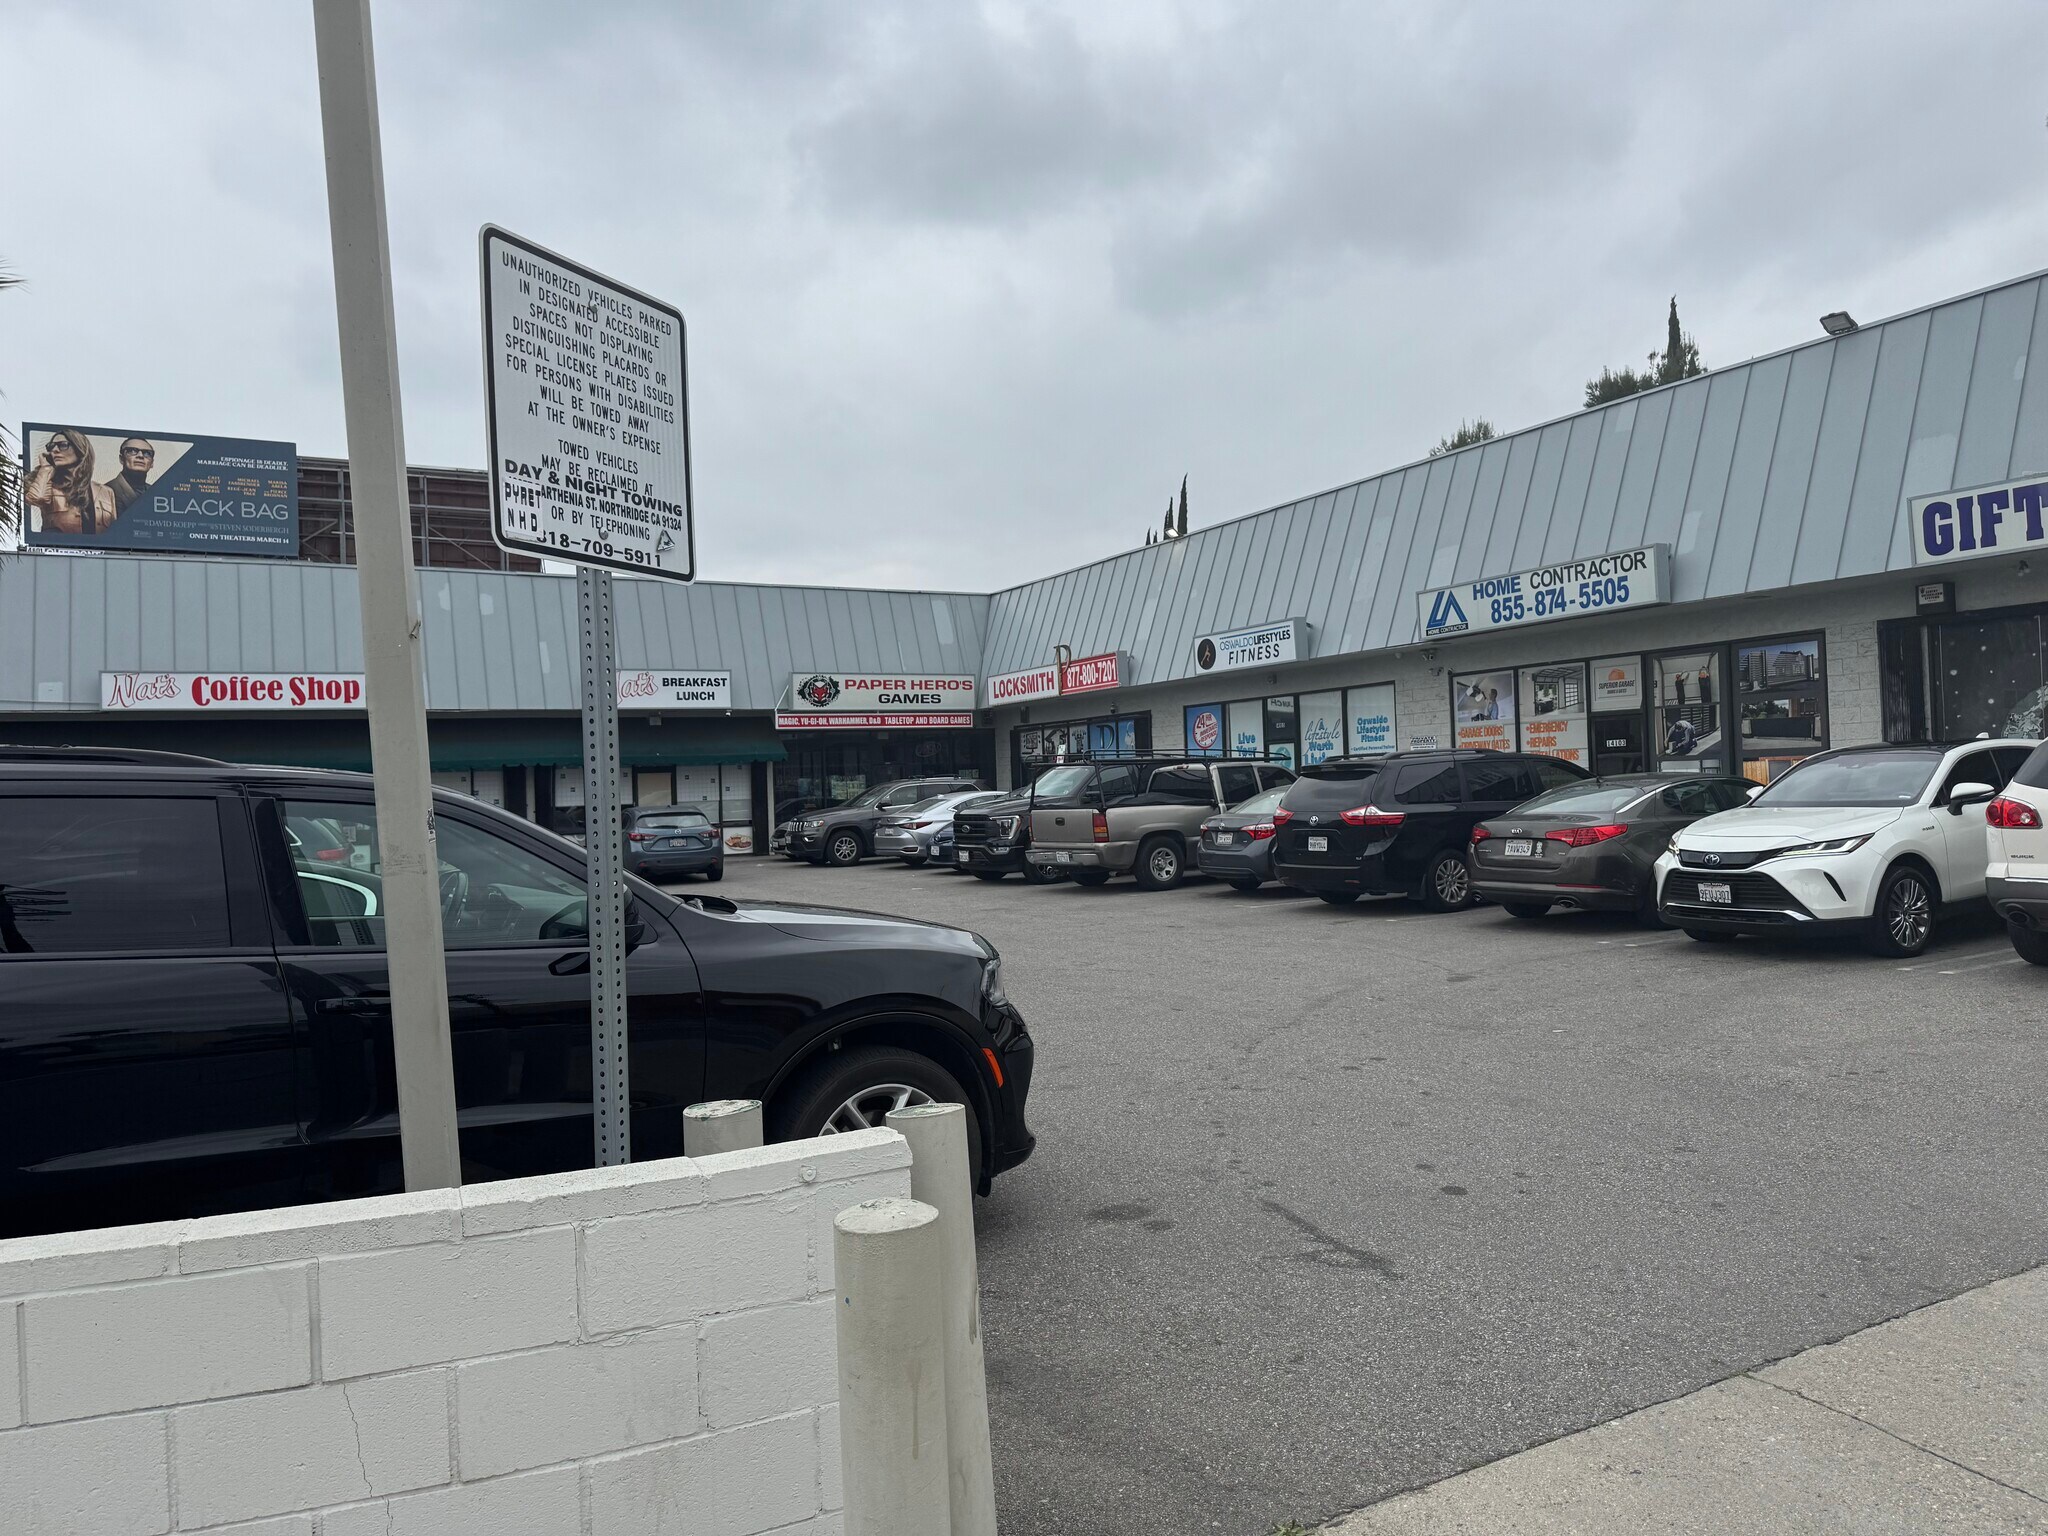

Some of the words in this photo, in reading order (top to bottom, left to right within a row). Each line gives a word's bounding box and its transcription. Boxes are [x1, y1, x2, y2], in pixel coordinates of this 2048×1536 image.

[502, 251, 581, 297] UNAUTHORIZED
[588, 289, 632, 319] VEHICLES
[639, 311, 671, 336] PARKED
[519, 278, 530, 295] IN
[538, 286, 598, 322] DESIGNATED
[605, 315, 660, 349] ACCESSIBLE
[529, 303, 567, 329] SPACES
[575, 321, 593, 340] NOT
[600, 331, 653, 364] DISPLAYING
[513, 316, 595, 359] DISTINGUISHING
[602, 351, 650, 380] PLACARDS
[655, 372, 667, 387] OR
[505, 333, 550, 362] SPECIAL
[556, 351, 598, 379] LICENSE
[604, 370, 637, 393] PLATES
[643, 384, 674, 407] ISSUED
[506, 354, 527, 374] FOR
[535, 364, 582, 392] PERSONS
[589, 382, 611, 403] WITH
[618, 393, 674, 424] DISABILITIES
[540, 385, 564, 406] WILL
[572, 396, 584, 412] BE
[590, 401, 621, 424] TOWED
[627, 415, 650, 433] AWAY
[528, 401, 539, 416] AT
[546, 406, 565, 425] THE
[572, 415, 616, 441] OWNER'S
[622, 431, 661, 455] EXPENSE
[558, 438, 589, 460] TOWED
[596, 450, 638, 475] VEHICLES
[542, 454, 560, 472] MAY
[568, 462, 581, 477] BE
[588, 467, 638, 492] RECLAIMED
[644, 483, 653, 496] AT
[504, 459, 542, 480] DAY
[548, 470, 560, 486] &
[565, 475, 617, 500] NIGHT
[622, 490, 682, 516] TOWING
[154, 496, 234, 517] BLACK
[241, 502, 288, 520] BAG
[541, 485, 584, 508] ARTHENIA
[586, 496, 598, 511] ST.
[600, 499, 649, 524] NORTHRIDGE
[651, 512, 660, 526] CA
[662, 516, 682, 531] 91324
[1922, 481, 2048, 557] GIFT
[149, 520, 172, 528] DAVID
[214, 524, 241, 532] STEVEN
[552, 506, 564, 521] OR
[572, 510, 584, 526] BY
[590, 514, 650, 540] TELEPHONING
[220, 534, 256, 542] THEATERS
[256, 536, 282, 544] MARCH
[1472, 576, 1521, 601] HOME
[1530, 551, 1648, 590] CONTRACTOR
[1428, 628, 1440, 636] HOME
[1440, 624, 1467, 633] CONTRACTOR
[1228, 644, 1280, 665] FITNESS
[107, 673, 181, 708] Nat's
[192, 676, 283, 706] Coffee
[288, 676, 360, 706] Shop
[618, 672, 658, 701] at's
[662, 678, 727, 687] BREAKFAST
[844, 679, 906, 690] PAPER
[910, 679, 974, 690] HERO'S
[993, 670, 1055, 699] LOCKSMITH
[1066, 658, 1117, 688] 877-800-7201
[1598, 681, 1618, 690] SUPERIOR
[1618, 680, 1636, 688] GARAGE
[676, 691, 715, 700] LUNCH
[878, 693, 942, 704] GAMES
[885, 715, 914, 724] TABLETOP
[916, 715, 928, 724] AND
[928, 715, 949, 724] BOARD
[950, 714, 971, 724] GAMES
[1356, 724, 1390, 735] Lifestyles
[1357, 715, 1388, 725] Oswaldo
[1530, 720, 1568, 734] EMERGENCY
[1238, 732, 1256, 744] Live
[1360, 734, 1385, 742] Fitness
[1460, 727, 1483, 738] GARAGE
[1484, 726, 1504, 736] DOORS
[1530, 736, 1557, 748] REPAIRS
[1308, 741, 1334, 752] Worth
[1492, 738, 1510, 751] GATES
